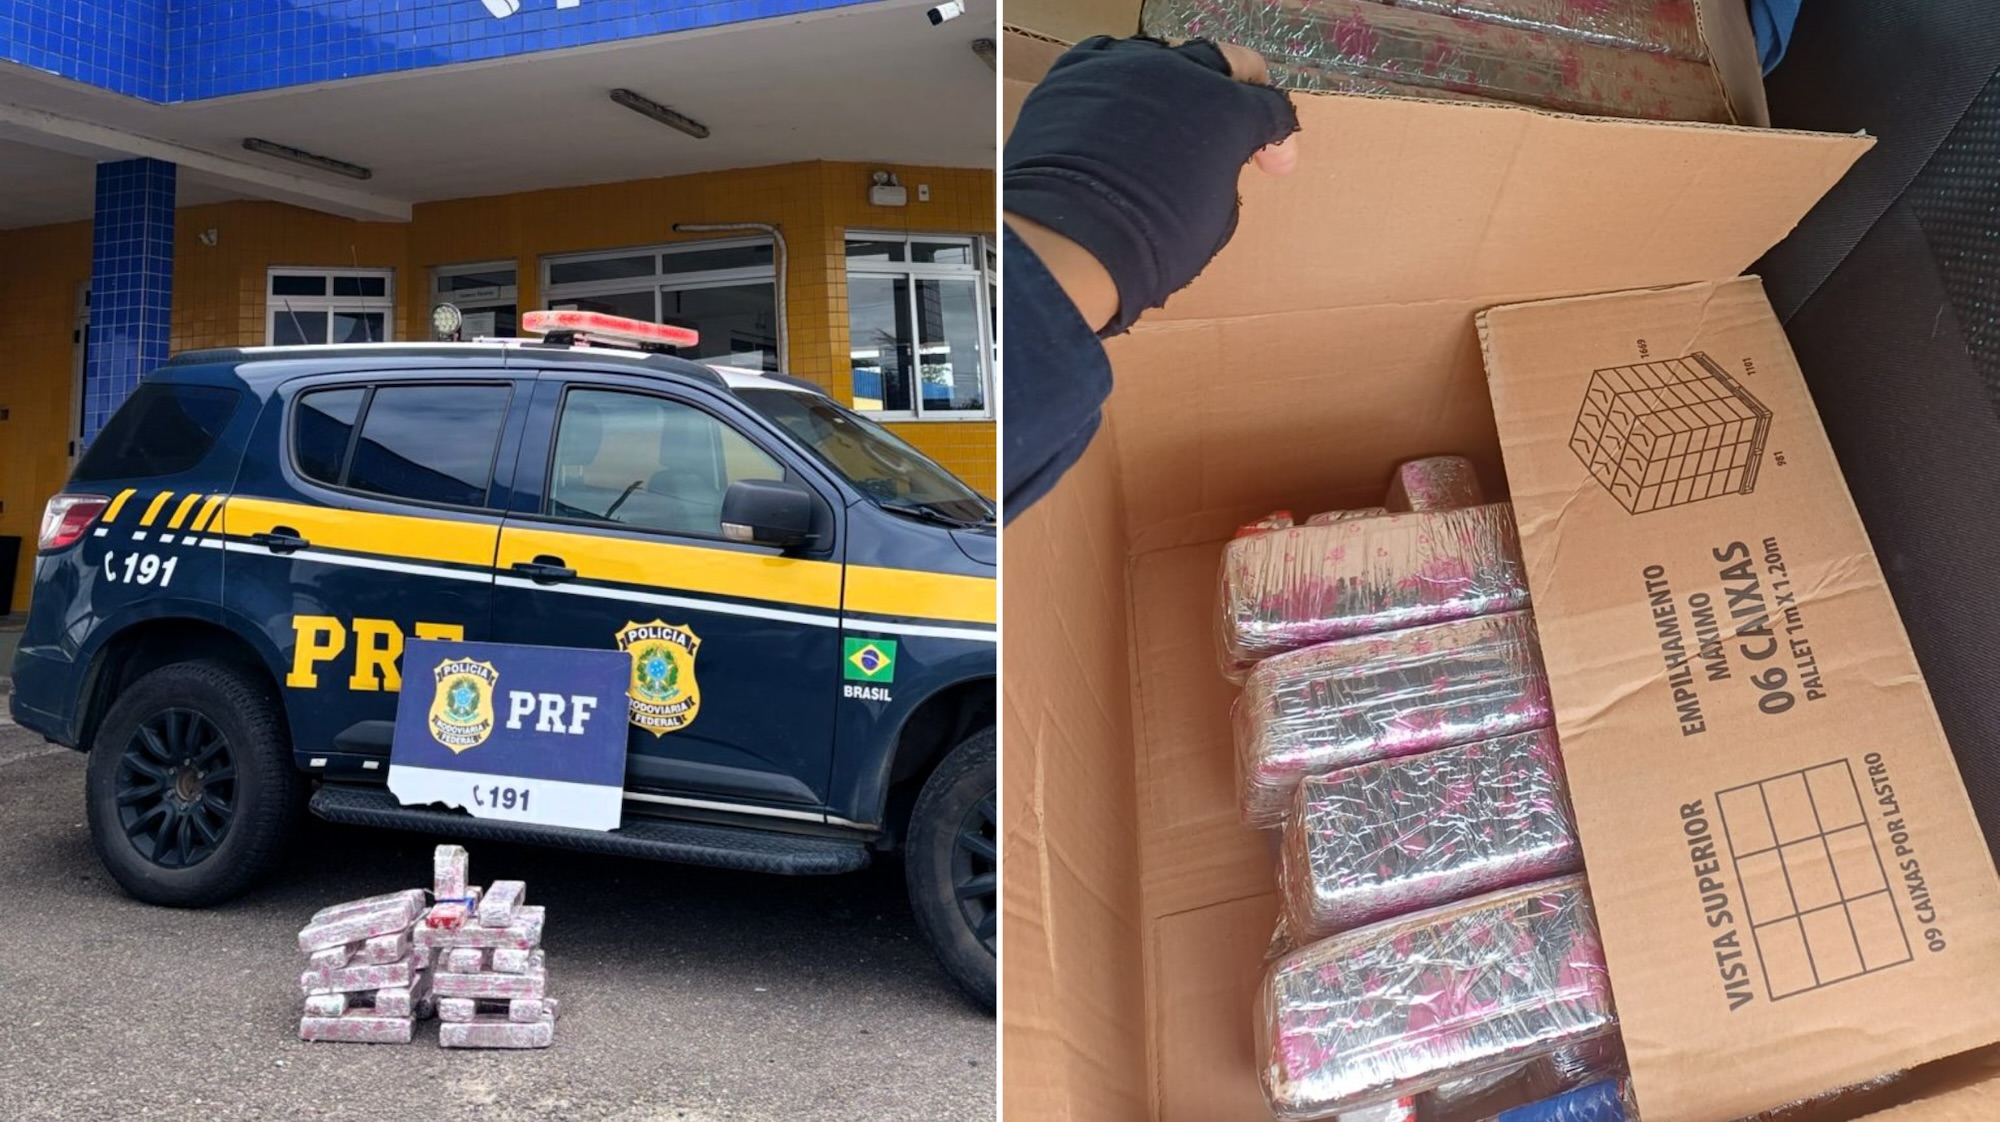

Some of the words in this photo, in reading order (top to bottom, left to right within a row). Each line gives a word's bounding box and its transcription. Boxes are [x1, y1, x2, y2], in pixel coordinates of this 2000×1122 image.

[1637, 339, 1650, 359] 1669
[1742, 357, 1756, 376] 1101
[1773, 450, 1787, 467] 981
[123, 552, 178, 587] 191
[1762, 536, 1790, 591] 1.20m
[1712, 541, 1778, 661] CAIXAS
[1784, 606, 1804, 635] 1m
[286, 614, 465, 692] PR
[1643, 564, 1707, 737] EMPILHAMENTO
[1789, 638, 1827, 702] PALLET
[843, 684, 893, 702] BRASIL
[1750, 667, 1796, 715] 06
[506, 690, 598, 735] PRF
[635, 713, 680, 727] FEDERAL
[441, 733, 476, 745] FEDERAL
[489, 785, 531, 812] 191
[1864, 752, 1901, 817] LASTRO
[1887, 817, 1914, 857] POR
[1679, 799, 1733, 928] SUPERIOR
[1900, 858, 1937, 925] CAIXAS
[1924, 927, 1947, 953] 09
[1713, 929, 1754, 1012] VISTA
